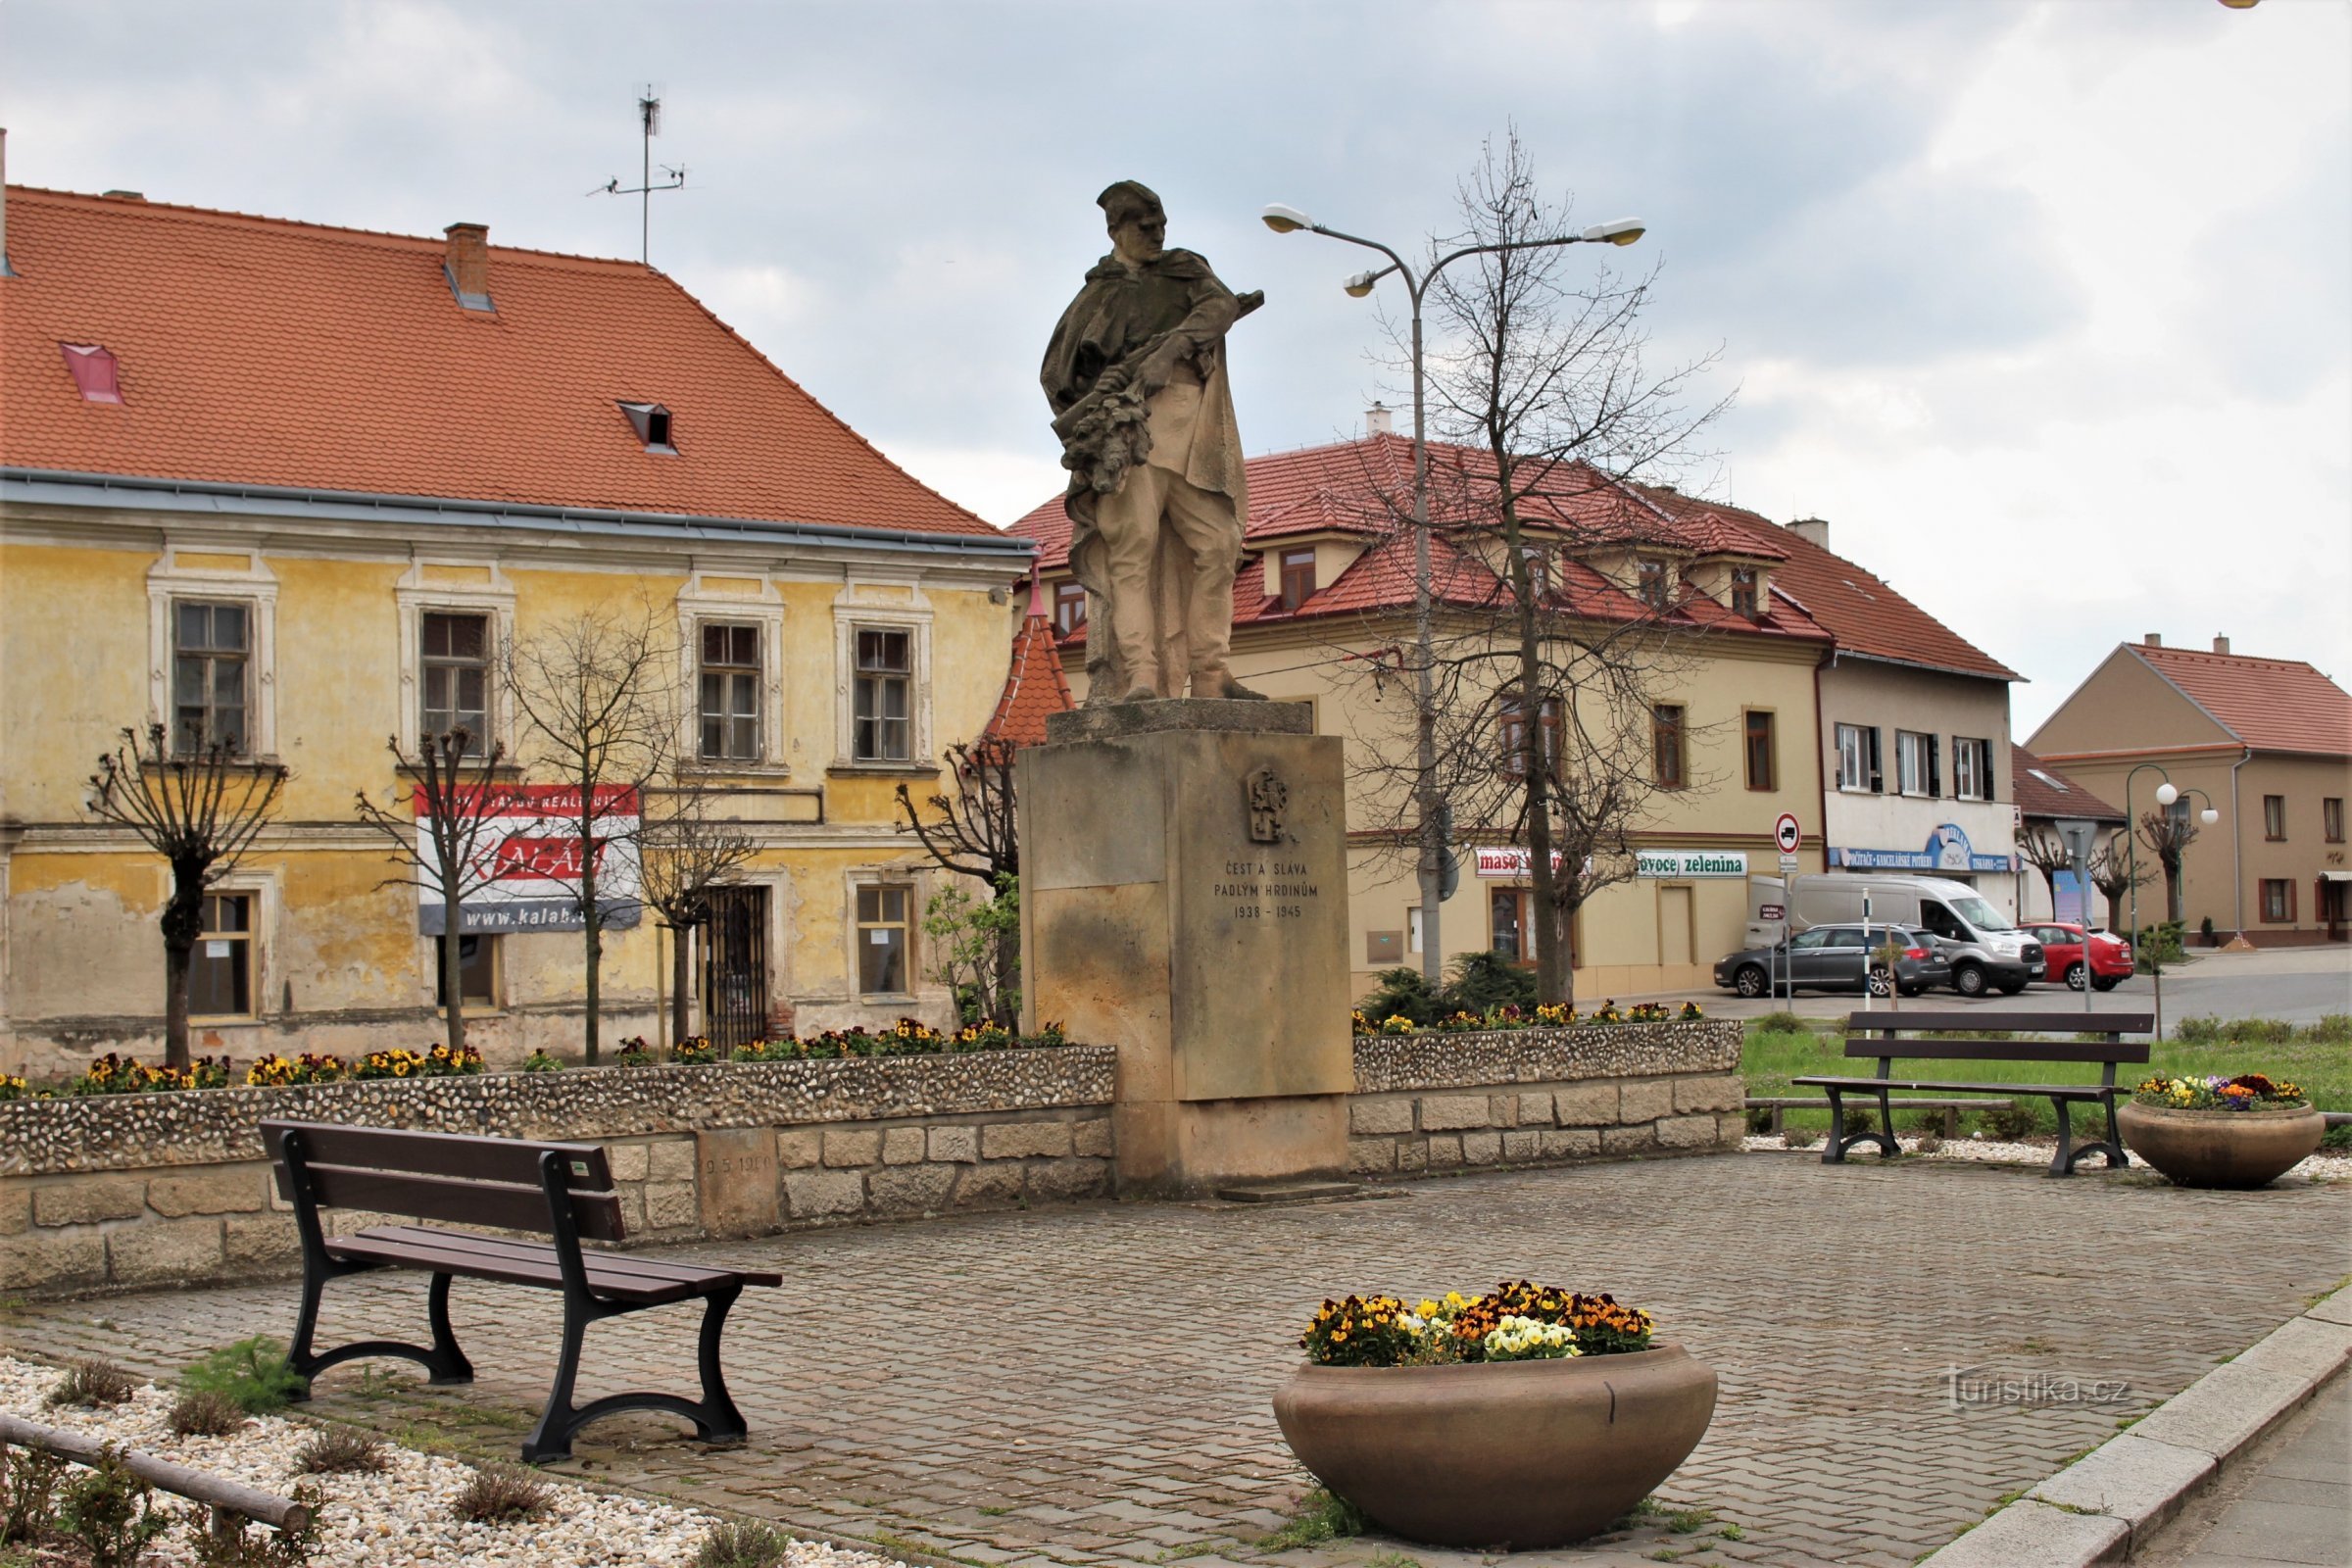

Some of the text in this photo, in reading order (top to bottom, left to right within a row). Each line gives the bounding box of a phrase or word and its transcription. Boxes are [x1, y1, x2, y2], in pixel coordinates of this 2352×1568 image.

[1226, 859, 1307, 875] ČEST A SLÁVA
[1480, 855, 1518, 870] maso
[1640, 858, 1677, 872] ovoce
[1685, 855, 1742, 872] zelenina
[1214, 881, 1318, 897] PADLÝM HRDINŮM
[1235, 906, 1260, 918] 1938
[1277, 906, 1301, 917] 1945
